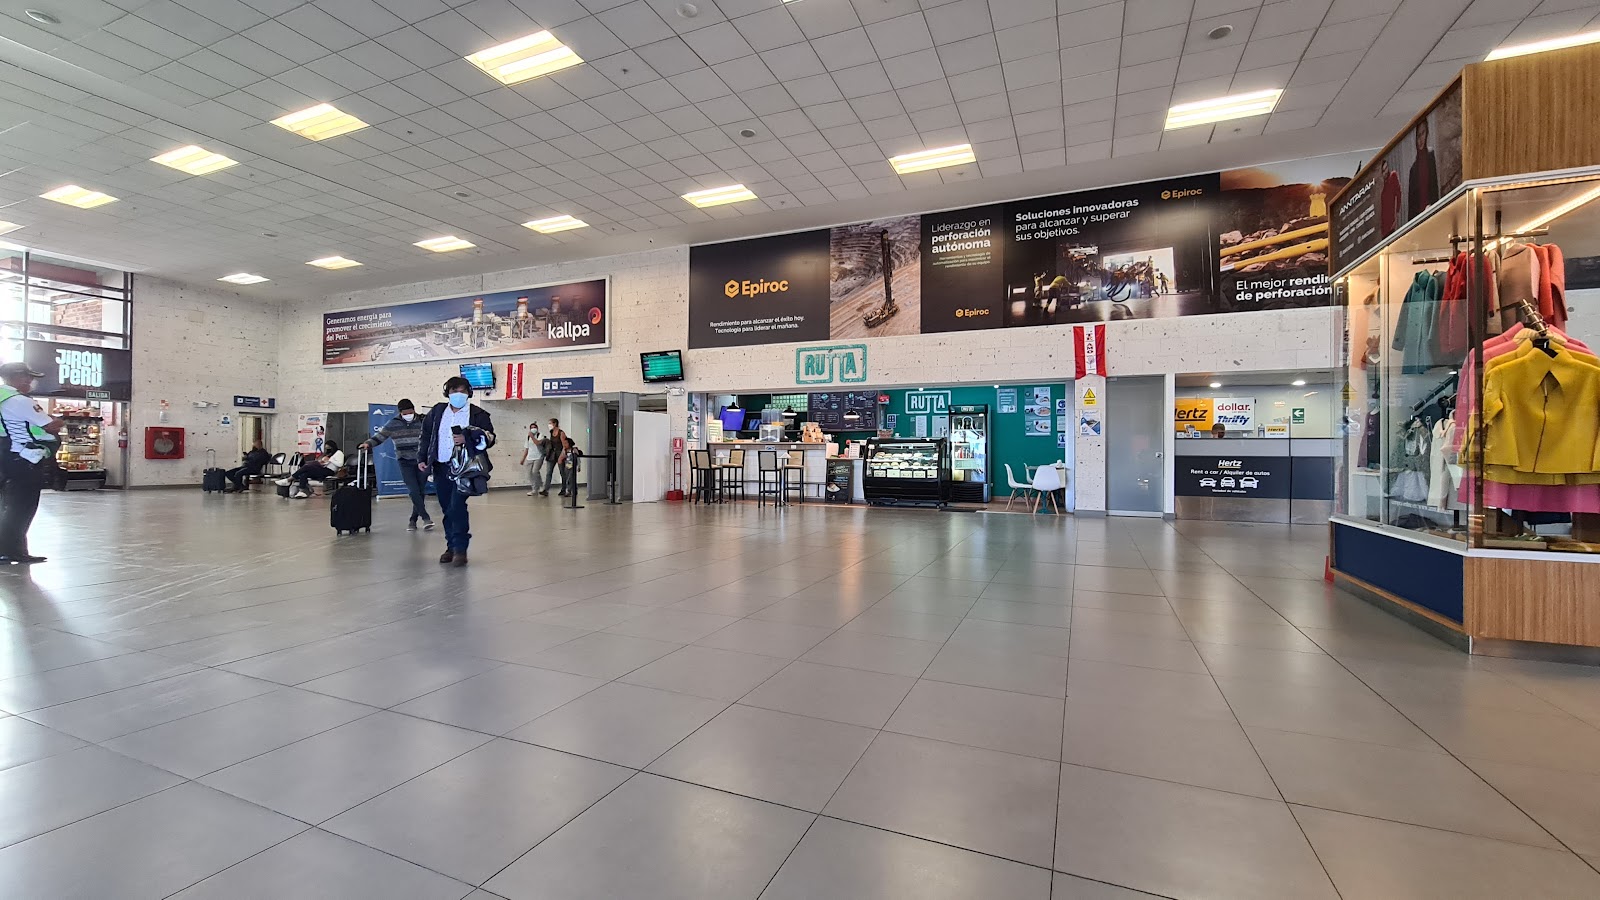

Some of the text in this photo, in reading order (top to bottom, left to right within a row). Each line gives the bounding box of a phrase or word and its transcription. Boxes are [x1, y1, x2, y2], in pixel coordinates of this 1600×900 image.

[1172, 188, 1202, 199] Epiroc
[1016, 199, 1140, 222] Soluciones innovadoras
[931, 218, 991, 232] Liderazgo en
[1016, 210, 1130, 233] para alcanzar y superar
[931, 228, 991, 245] perforación
[1016, 227, 1080, 242] sus objetivos.
[931, 239, 991, 254] autónoma
[742, 279, 789, 298] Epiroc
[1236, 280, 1248, 290] El
[1250, 278, 1286, 290] mejor
[1235, 291, 1253, 301] de
[1255, 286, 1332, 302] perforación
[326, 312, 392, 325] Generamos energía para
[964, 308, 990, 318] Epiroc
[326, 325, 352, 335] promover
[359, 321, 392, 330] crecimiento
[548, 322, 590, 341] kallpa
[804, 352, 856, 375] RUTTA
[910, 395, 945, 409] RUTTA
[1218, 415, 1250, 425] Thrifty
